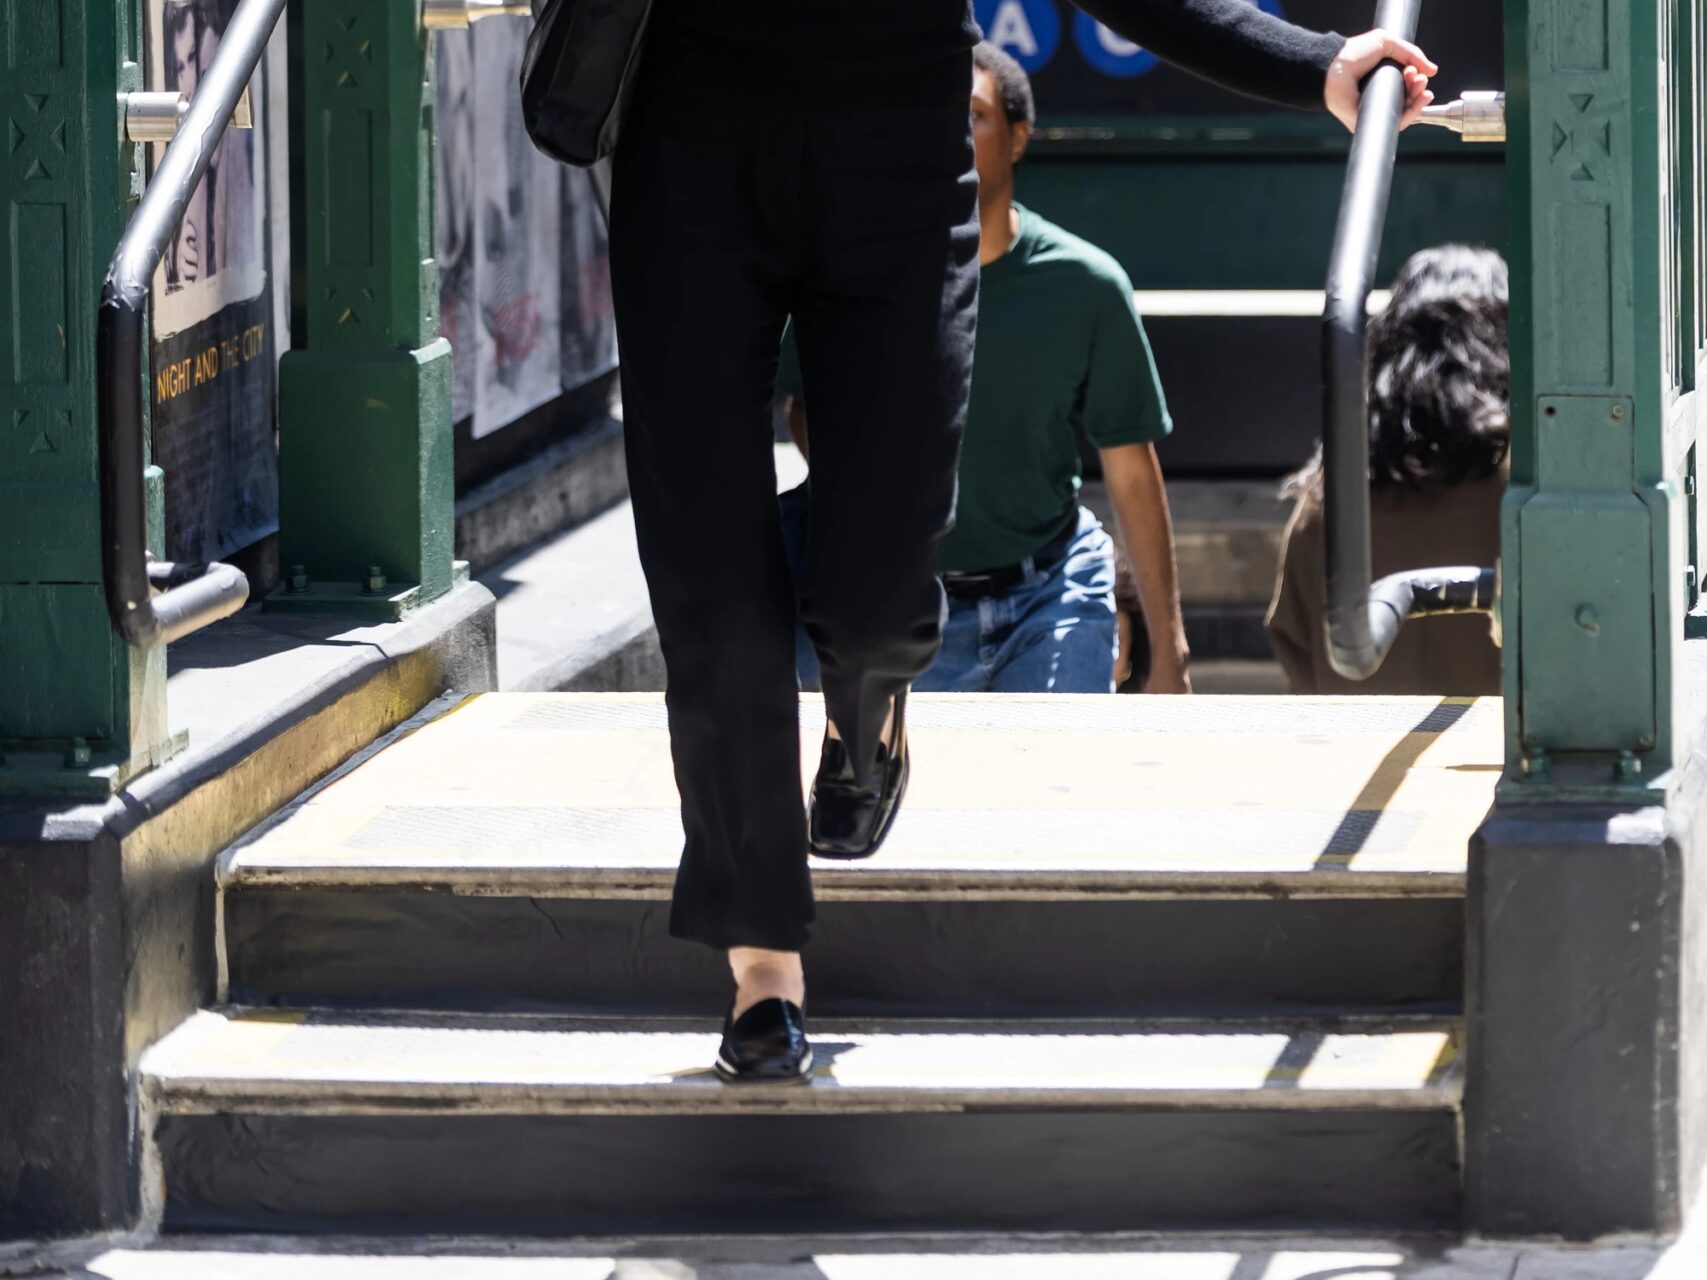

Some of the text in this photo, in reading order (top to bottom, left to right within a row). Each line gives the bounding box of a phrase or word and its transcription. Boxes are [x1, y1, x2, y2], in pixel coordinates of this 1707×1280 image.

[156, 322, 265, 404] NIGHT AND THE CITY
